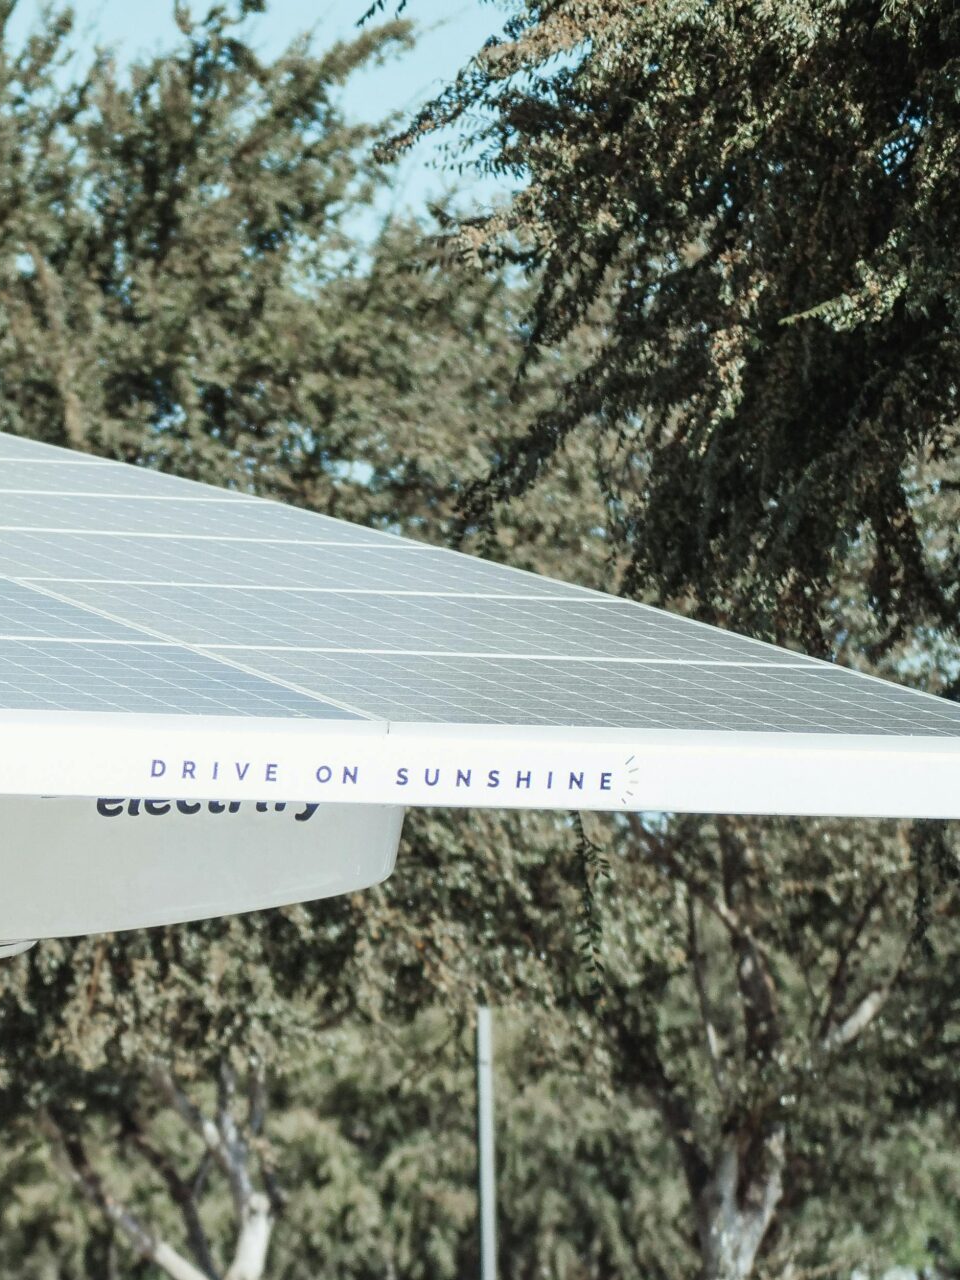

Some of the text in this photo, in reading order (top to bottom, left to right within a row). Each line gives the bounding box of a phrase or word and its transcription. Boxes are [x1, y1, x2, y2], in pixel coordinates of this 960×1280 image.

[150, 759, 613, 791] DRIVE ON SUNSHINE
